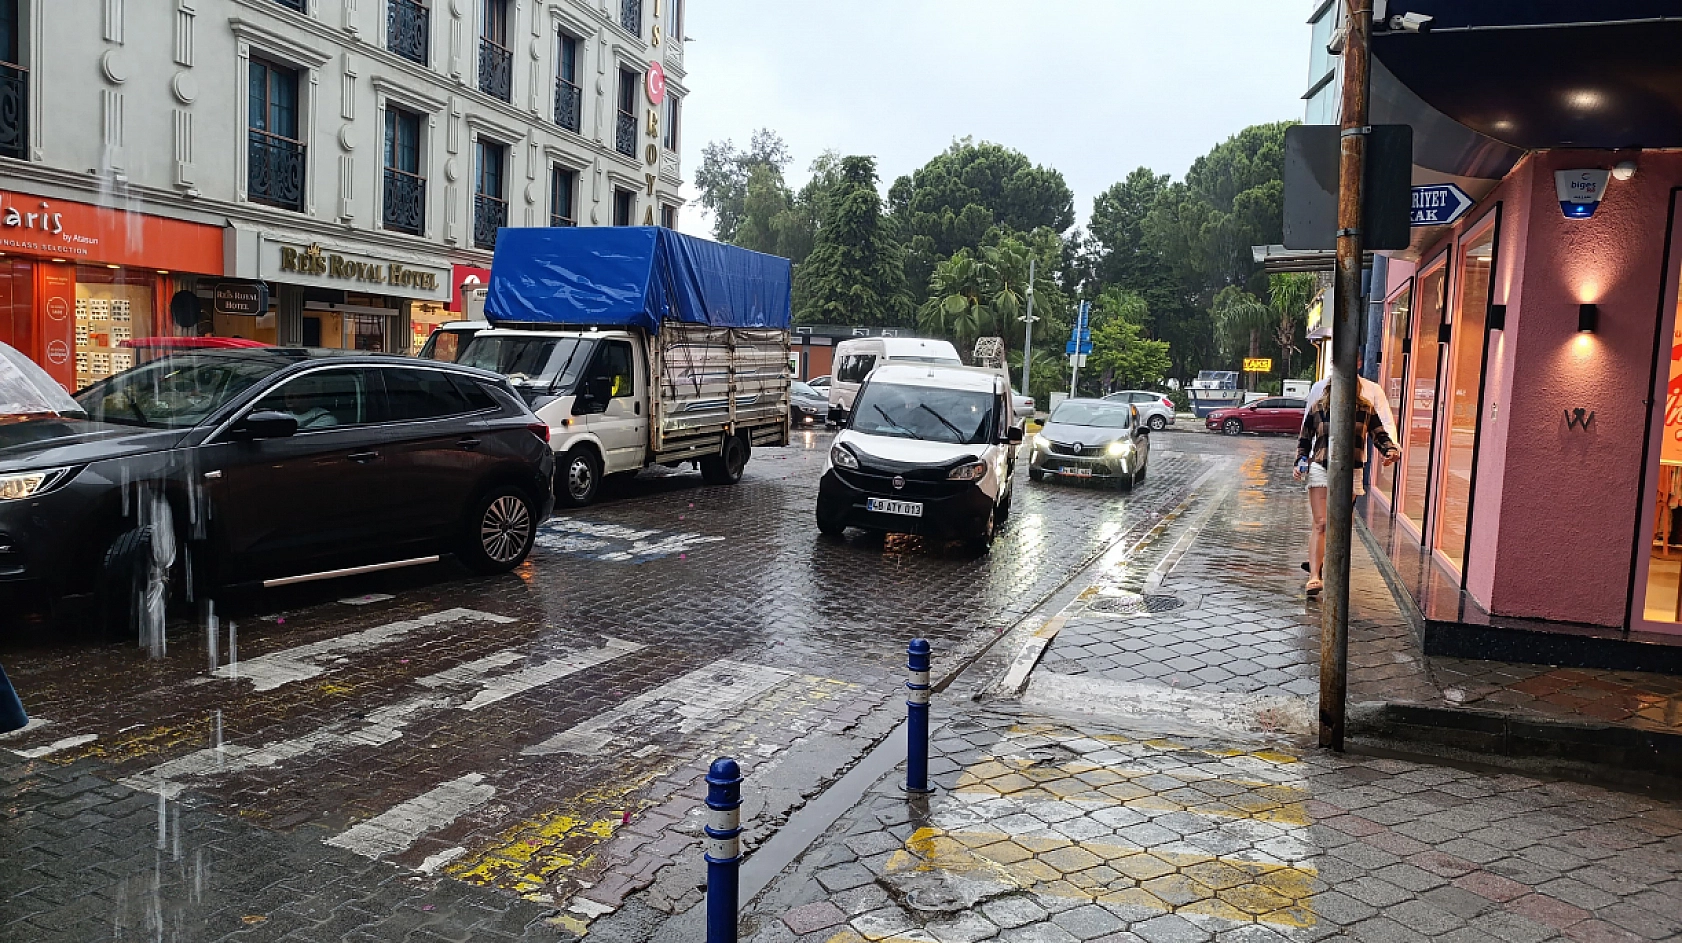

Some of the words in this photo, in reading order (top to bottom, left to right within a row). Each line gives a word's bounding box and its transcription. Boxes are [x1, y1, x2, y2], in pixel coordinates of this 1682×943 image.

[62, 232, 72, 242] by
[329, 253, 387, 283] ROYAL
[388, 263, 440, 290] HOTEL
